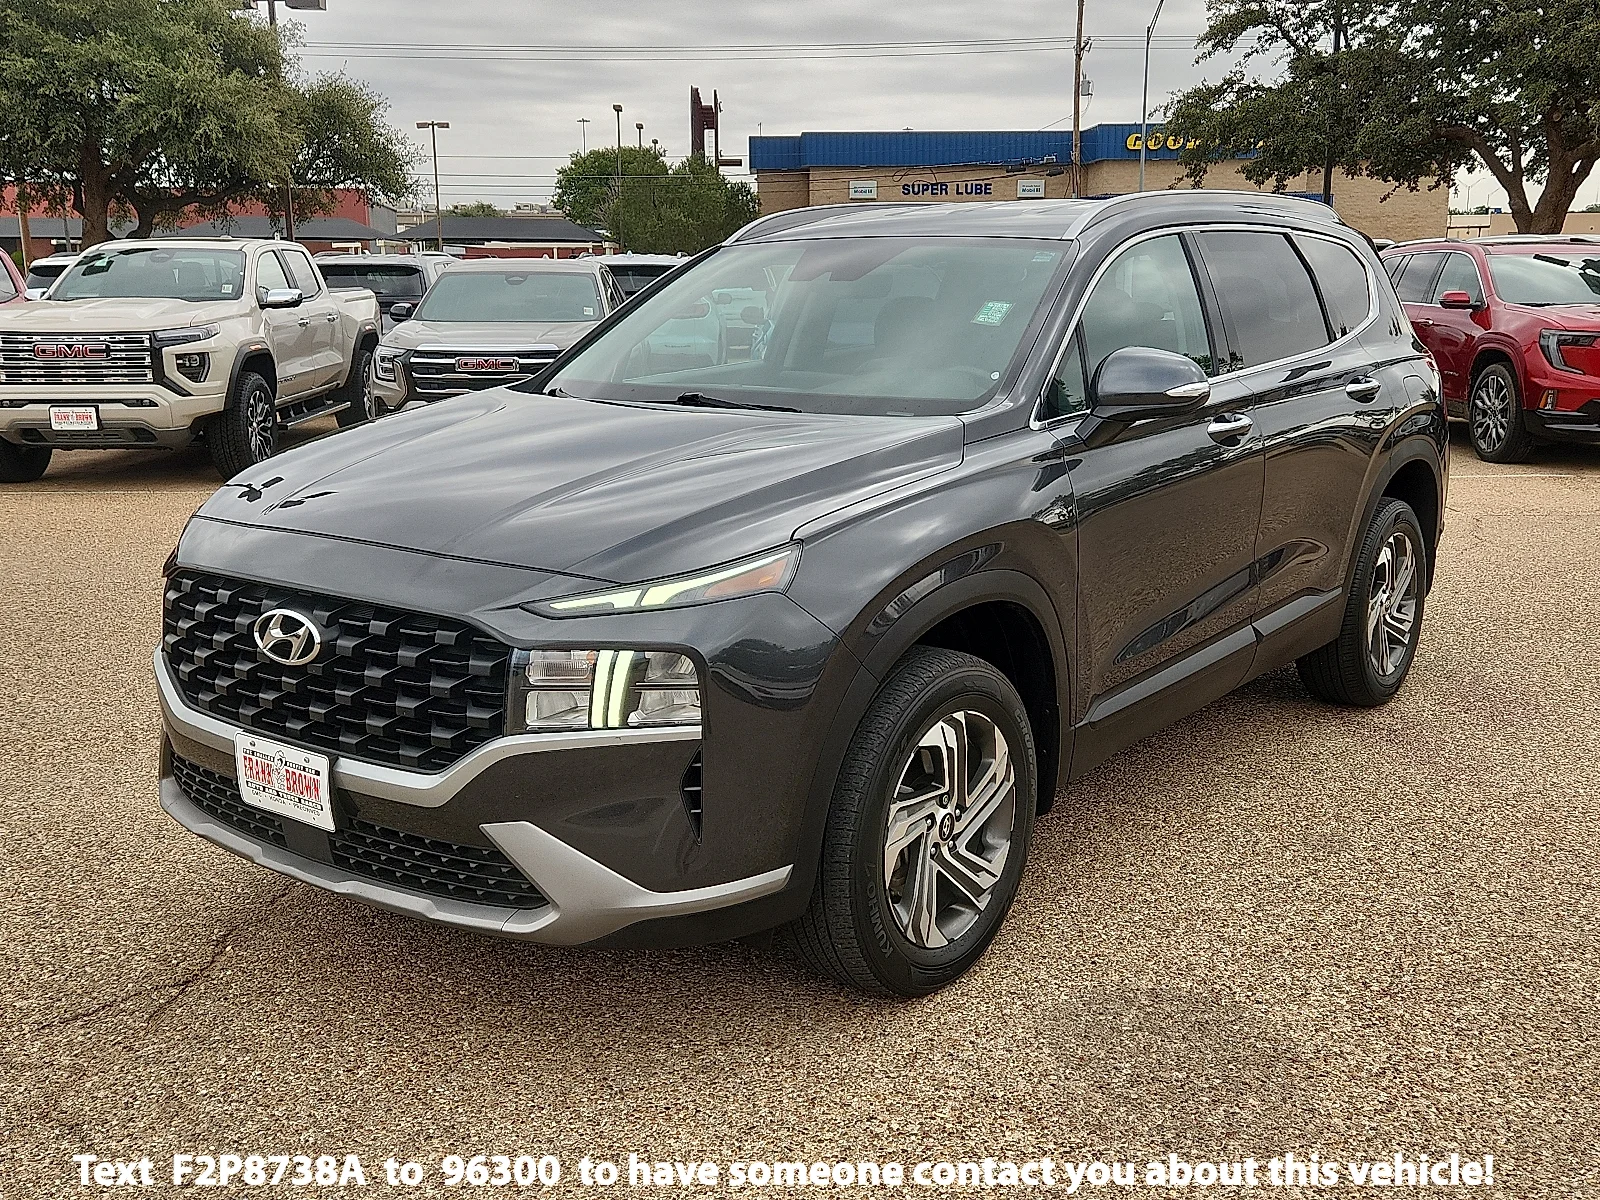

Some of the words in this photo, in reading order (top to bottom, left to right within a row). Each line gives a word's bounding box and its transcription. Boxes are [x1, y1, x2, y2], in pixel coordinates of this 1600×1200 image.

[901, 183, 949, 196] SUPER
[955, 183, 993, 195] LUBE
[34, 344, 106, 358] GMC
[460, 358, 515, 370] GMC
[243, 755, 275, 786] FRANK
[285, 769, 321, 802] BROWN
[867, 881, 894, 959] KUMHO
